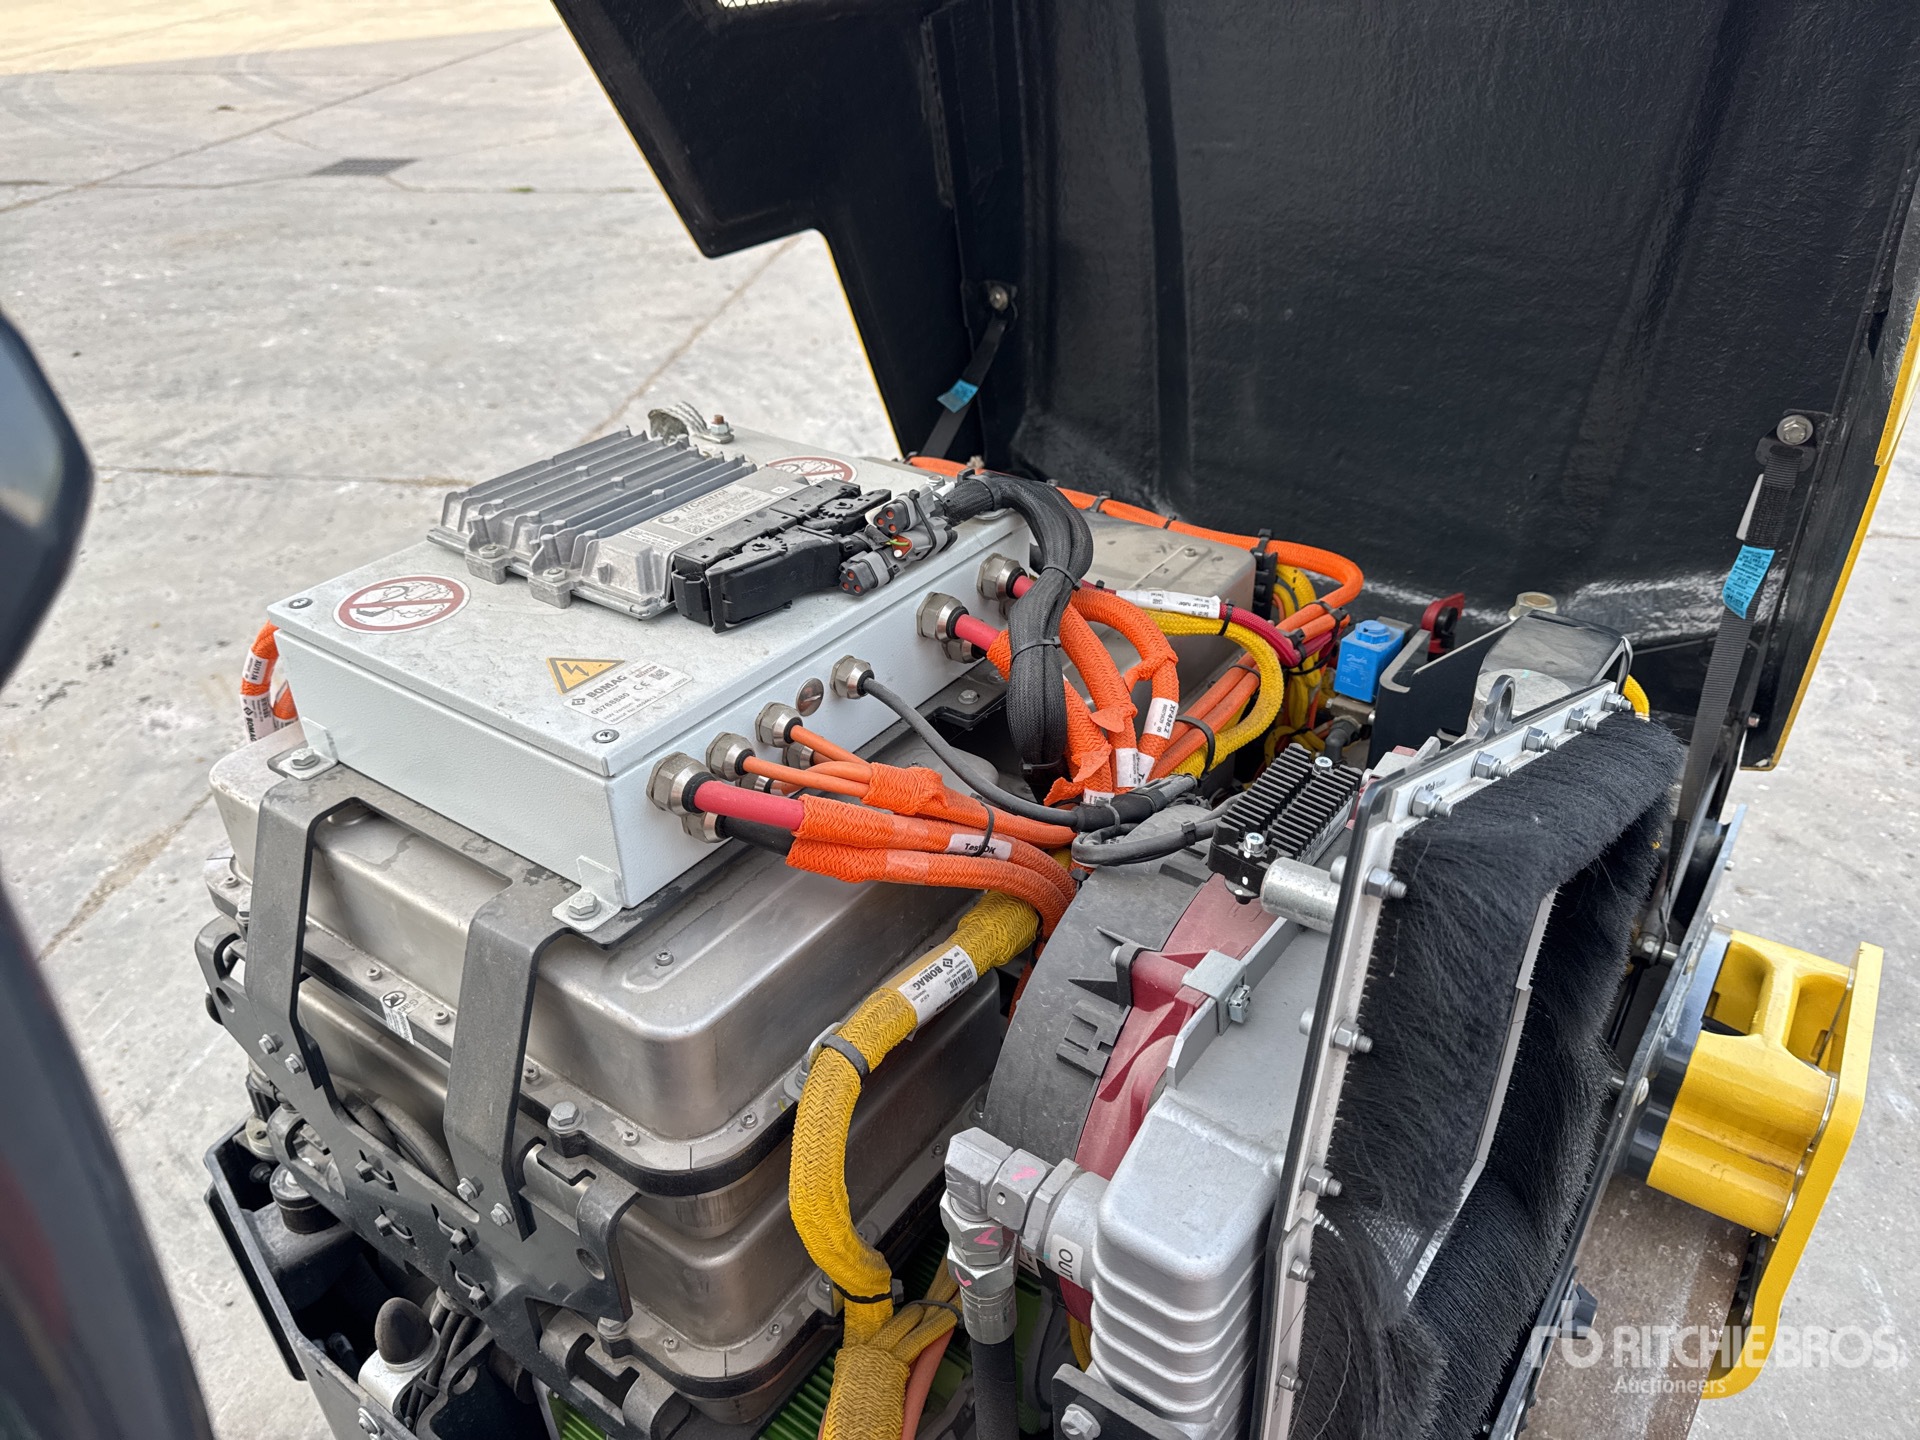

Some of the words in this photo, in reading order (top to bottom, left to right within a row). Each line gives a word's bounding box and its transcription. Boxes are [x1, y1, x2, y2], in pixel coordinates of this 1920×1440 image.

[586, 674, 628, 698] BOMAG
[913, 966, 943, 990] BOMAG
[1058, 1248, 1074, 1281] OUT
